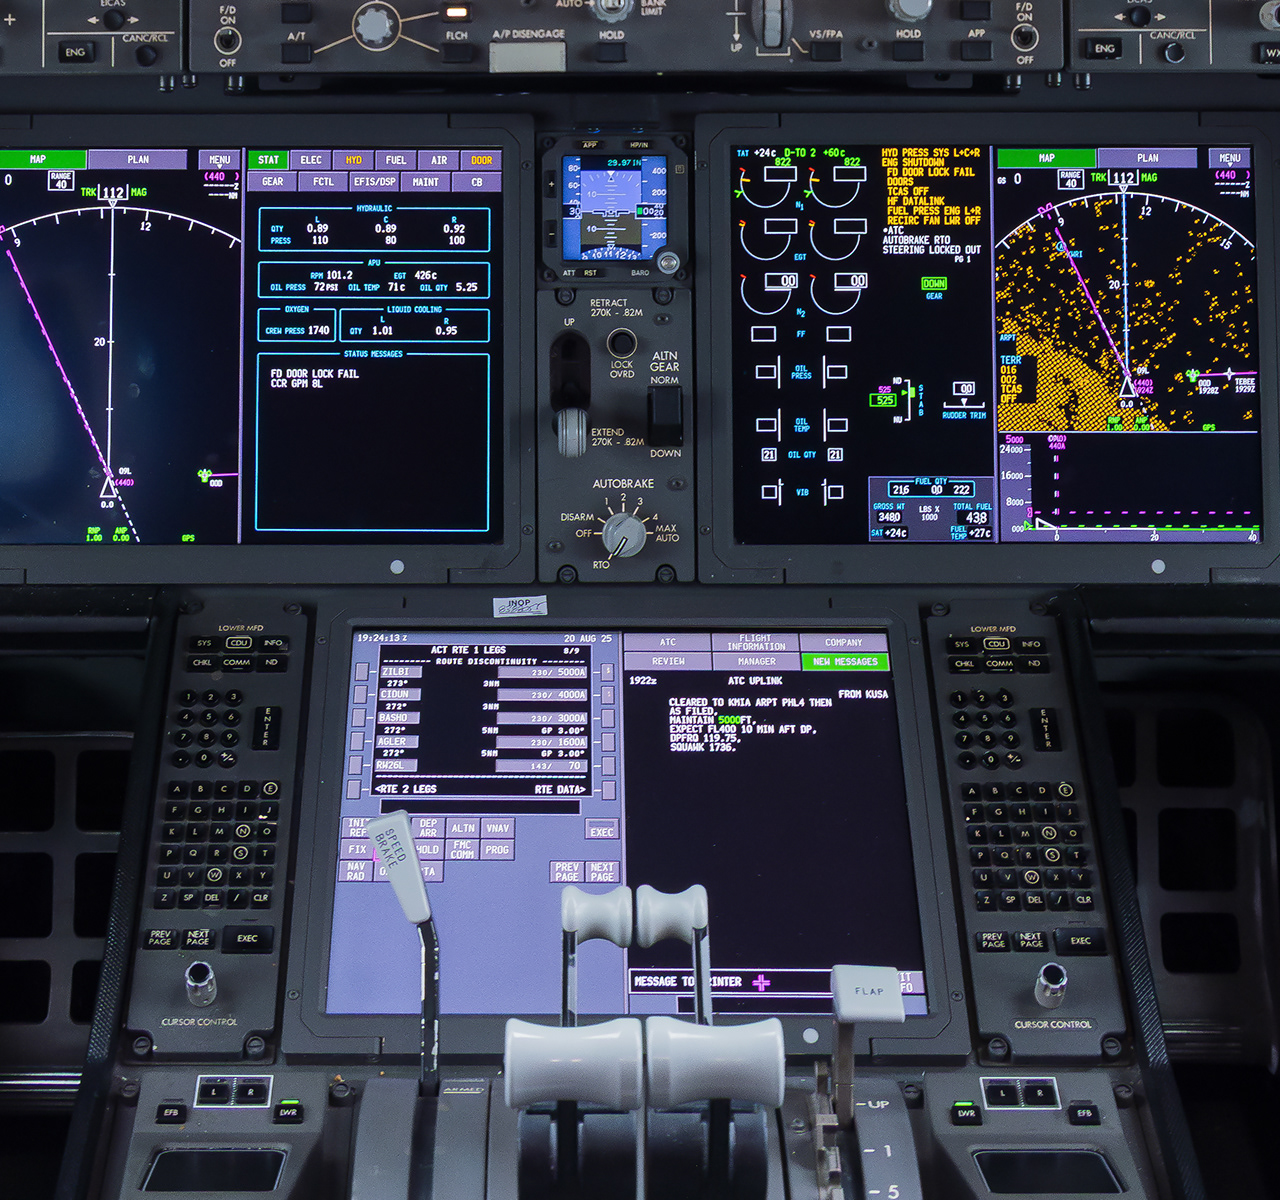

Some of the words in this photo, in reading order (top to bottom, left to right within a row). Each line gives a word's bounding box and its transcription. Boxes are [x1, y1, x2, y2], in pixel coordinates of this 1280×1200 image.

[641, 7, 663, 16] LIMIT
[493, 30, 510, 38] A/P
[512, 29, 564, 38] DISENGAGE
[599, 31, 624, 39] HOLD
[810, 30, 843, 38] VS/FPA
[122, 33, 168, 43] CANC/RCL
[66, 48, 85, 56] ENG
[882, 148, 898, 157] HYD
[902, 148, 930, 157] PRESS
[933, 148, 949, 157] SYS
[30, 155, 46, 163] MAP
[128, 155, 149, 163] PLAN
[258, 155, 279, 164] STAT
[301, 156, 321, 164] ELEC
[346, 155, 362, 164] HYD
[386, 156, 406, 164] FUEL
[431, 156, 447, 164] AIR
[471, 156, 492, 164] DOOR
[882, 158, 898, 166] ENG
[902, 158, 944, 166] SHUTDOWN
[263, 177, 283, 185] GEAR
[314, 177, 334, 186] FCTL
[355, 177, 396, 186] EFIS/DSP
[413, 178, 438, 186] MAINT
[883, 236, 930, 244] AUTOBRAKE
[934, 236, 950, 244] RTO
[883, 246, 925, 254] STEERING
[929, 246, 961, 254] LOCKED
[965, 246, 981, 254] OUT
[923, 279, 945, 288] DOWN
[591, 299, 627, 307] RETRACT
[371, 350, 403, 358] MESSAGES
[653, 351, 677, 360] ALTN
[650, 362, 679, 371] GEAR
[271, 369, 282, 378] FD
[286, 369, 308, 378] DOOR
[312, 369, 333, 378] LOCK
[338, 369, 359, 378] FAIL
[592, 428, 624, 436] EXTEND
[593, 479, 654, 488] AUTOBRAKE
[561, 513, 594, 521] DISARM
[593, 561, 610, 569] RTO
[509, 599, 530, 607] INOP
[739, 634, 771, 642] FLIGHT
[826, 639, 862, 647] COMPANY
[813, 657, 830, 666] NEW
[834, 657, 878, 666] MESSAGES
[378, 737, 406, 745] AGLER
[535, 785, 553, 794] RTE
[385, 828, 407, 862] SPEED
[375, 833, 399, 869] BRAKE
[855, 987, 883, 995] FLAP
[162, 1018, 195, 1026] CURSOR
[197, 1018, 237, 1026] CONTROL
[164, 1108, 179, 1117] EFB
